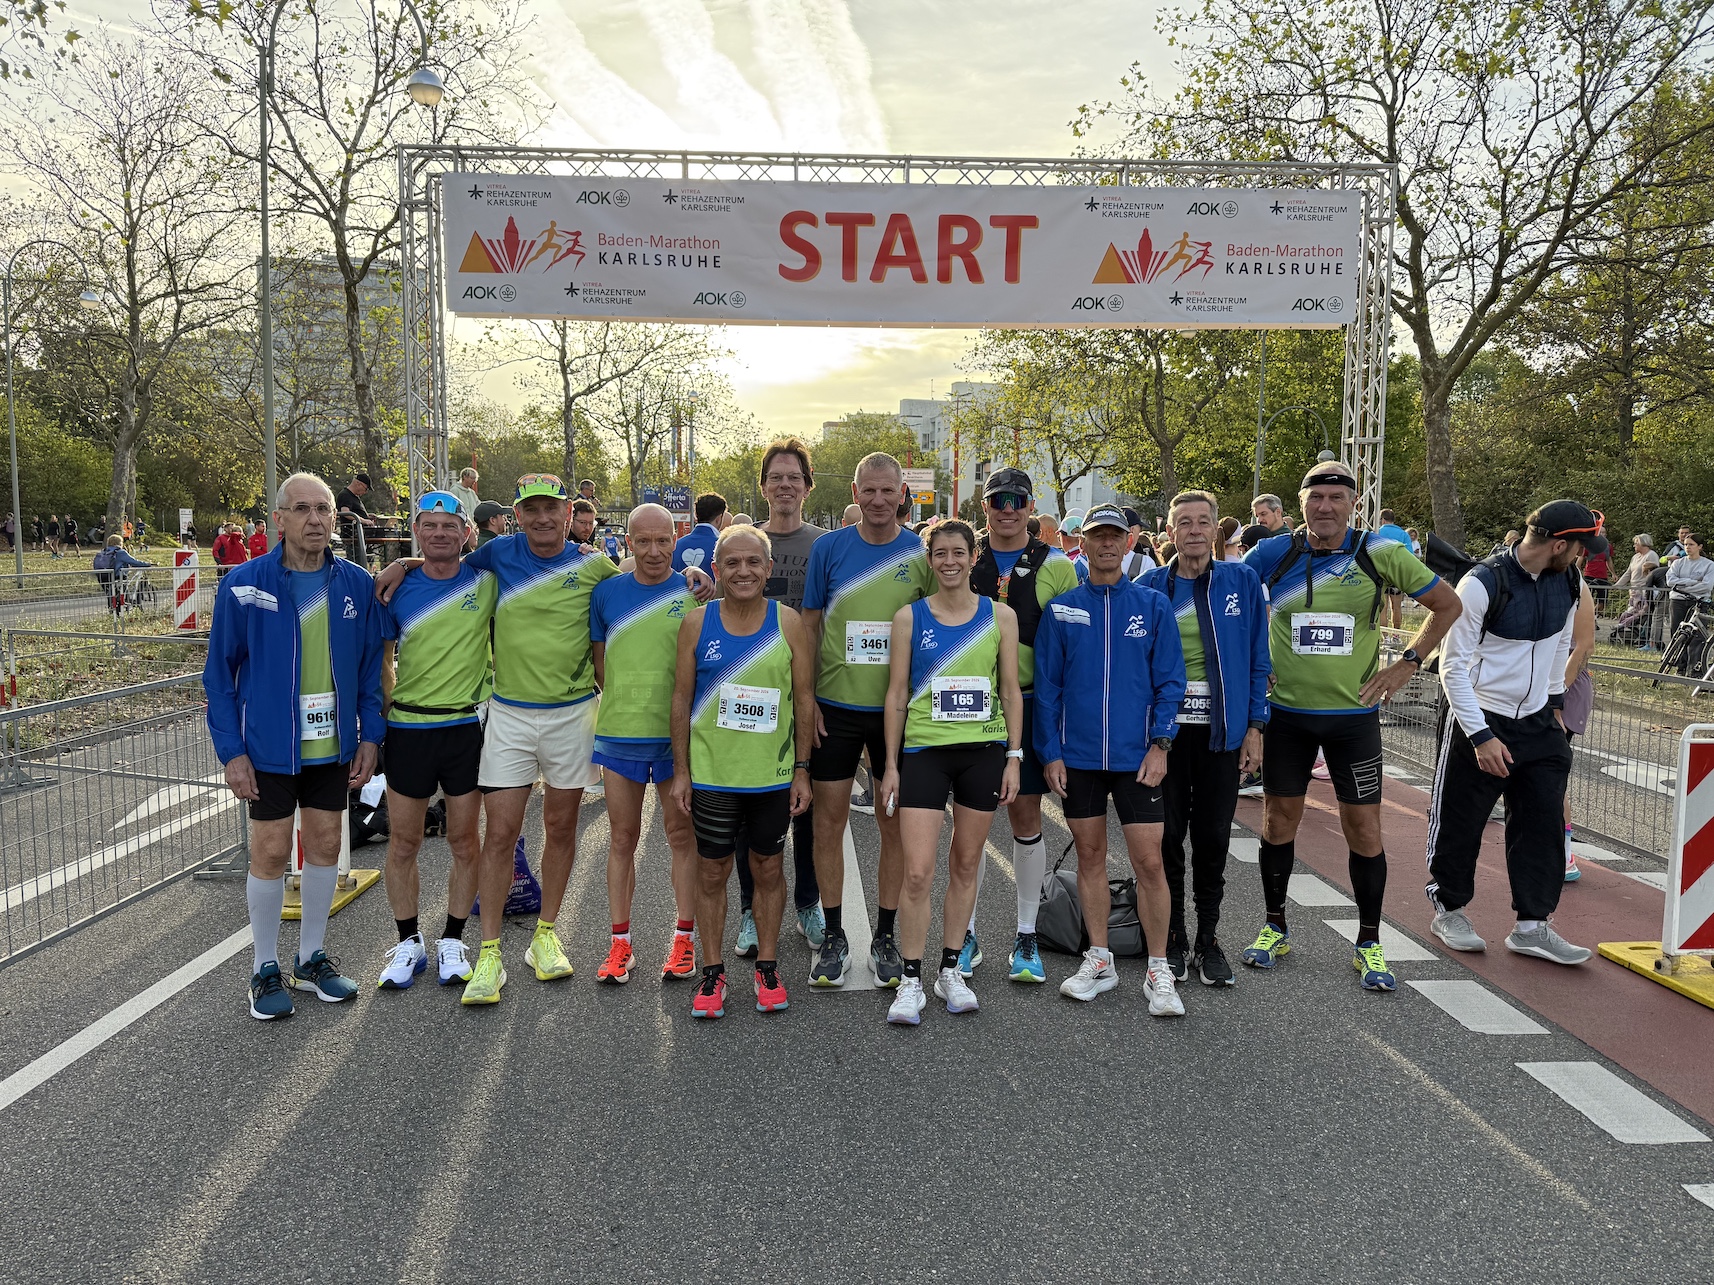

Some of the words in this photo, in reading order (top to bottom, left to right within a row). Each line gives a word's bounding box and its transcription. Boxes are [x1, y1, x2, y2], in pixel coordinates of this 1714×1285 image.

[486, 190, 551, 199] REHAZENTRUM
[576, 191, 611, 205] AOK
[681, 195, 745, 204] REHAZENTRUM
[1186, 202, 1220, 216] AOK
[598, 232, 720, 250] Baden-Marathon
[778, 210, 1039, 284] START
[1226, 244, 1343, 257] Baden-Marathon
[598, 252, 721, 269] KARLSRUHE
[1226, 262, 1343, 275] KARLSRUHE
[462, 286, 497, 300] AOK
[582, 288, 646, 296] REHAZENTRUM
[692, 292, 727, 306] AOK
[1071, 297, 1105, 310] AOK
[1186, 296, 1247, 304] REHAZENTRUM
[1291, 298, 1325, 311] AOK
[1310, 629, 1334, 640] 799
[861, 639, 888, 649] 3461
[952, 694, 974, 706] 165
[1184, 698, 1211, 709] 2055
[734, 703, 764, 716] 3508
[307, 710, 335, 724] 9616
